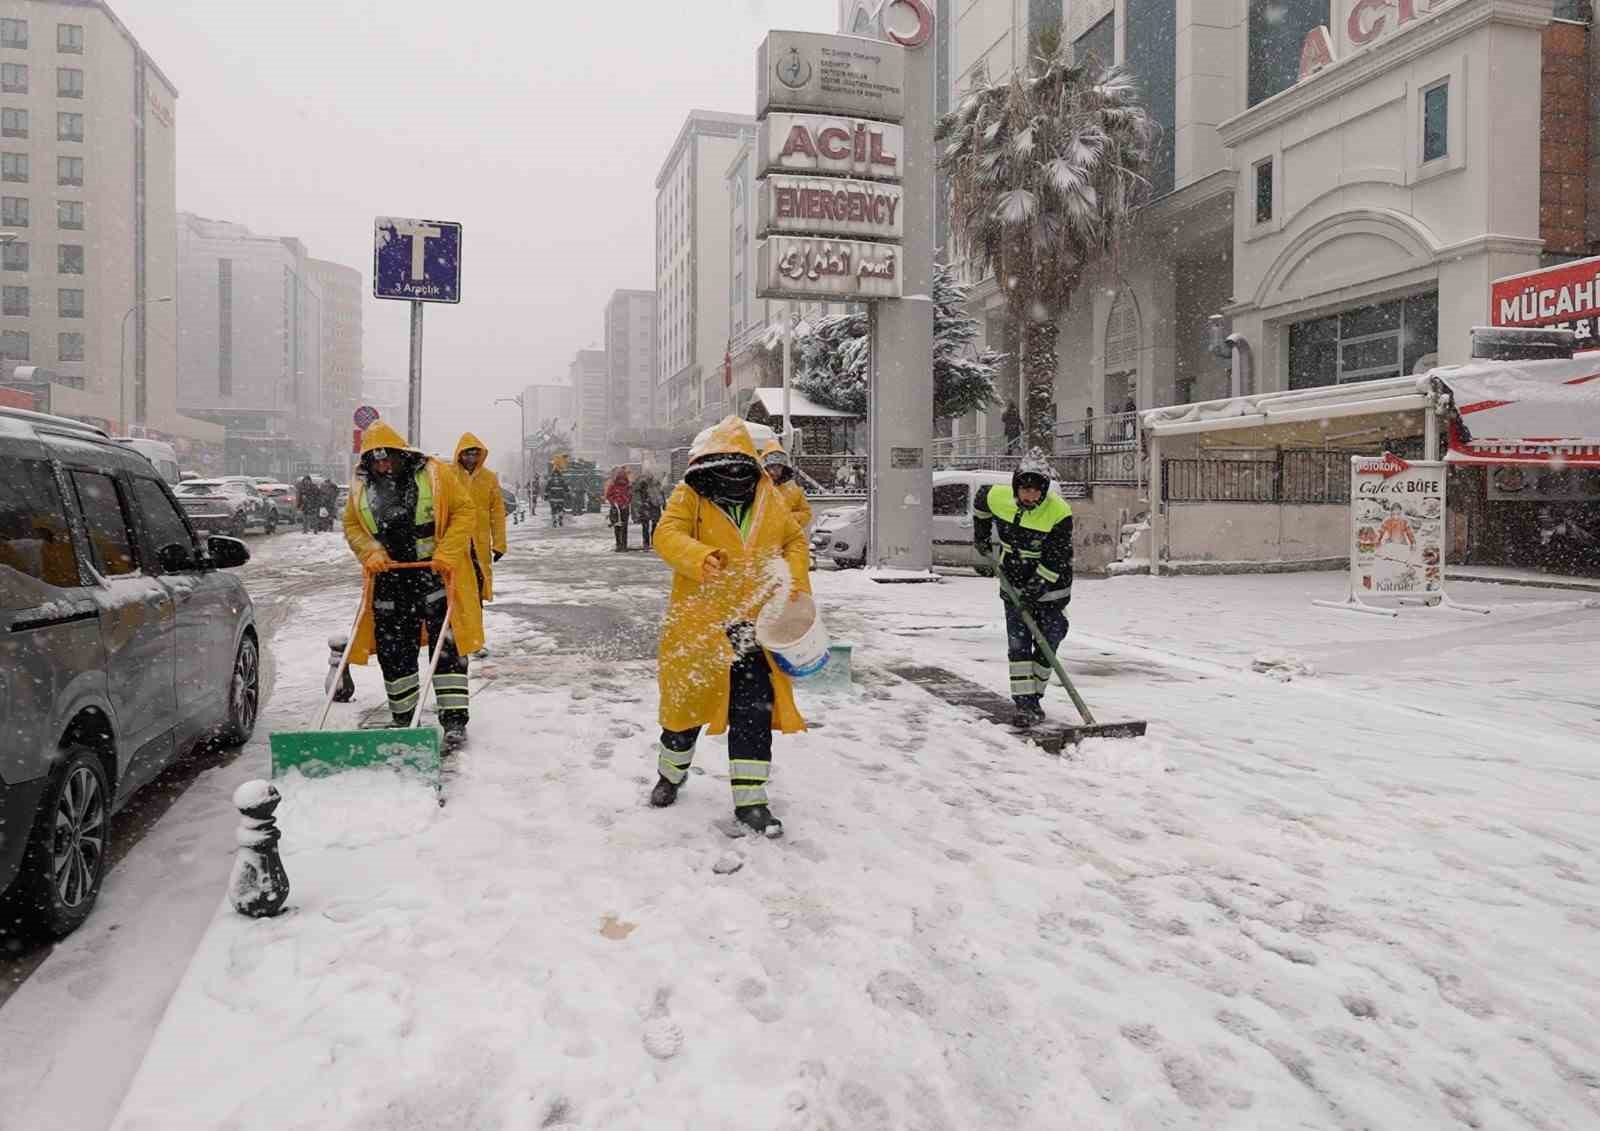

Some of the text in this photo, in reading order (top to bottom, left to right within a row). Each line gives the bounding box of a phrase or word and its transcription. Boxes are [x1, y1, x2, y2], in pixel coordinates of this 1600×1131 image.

[781, 123, 897, 164] ACİL
[775, 187, 900, 225] EMERGENCY
[396, 224, 441, 280] T
[394, 282, 440, 295] 3 Araçlık
[1359, 478, 1439, 494] Cafe & BÜFE
